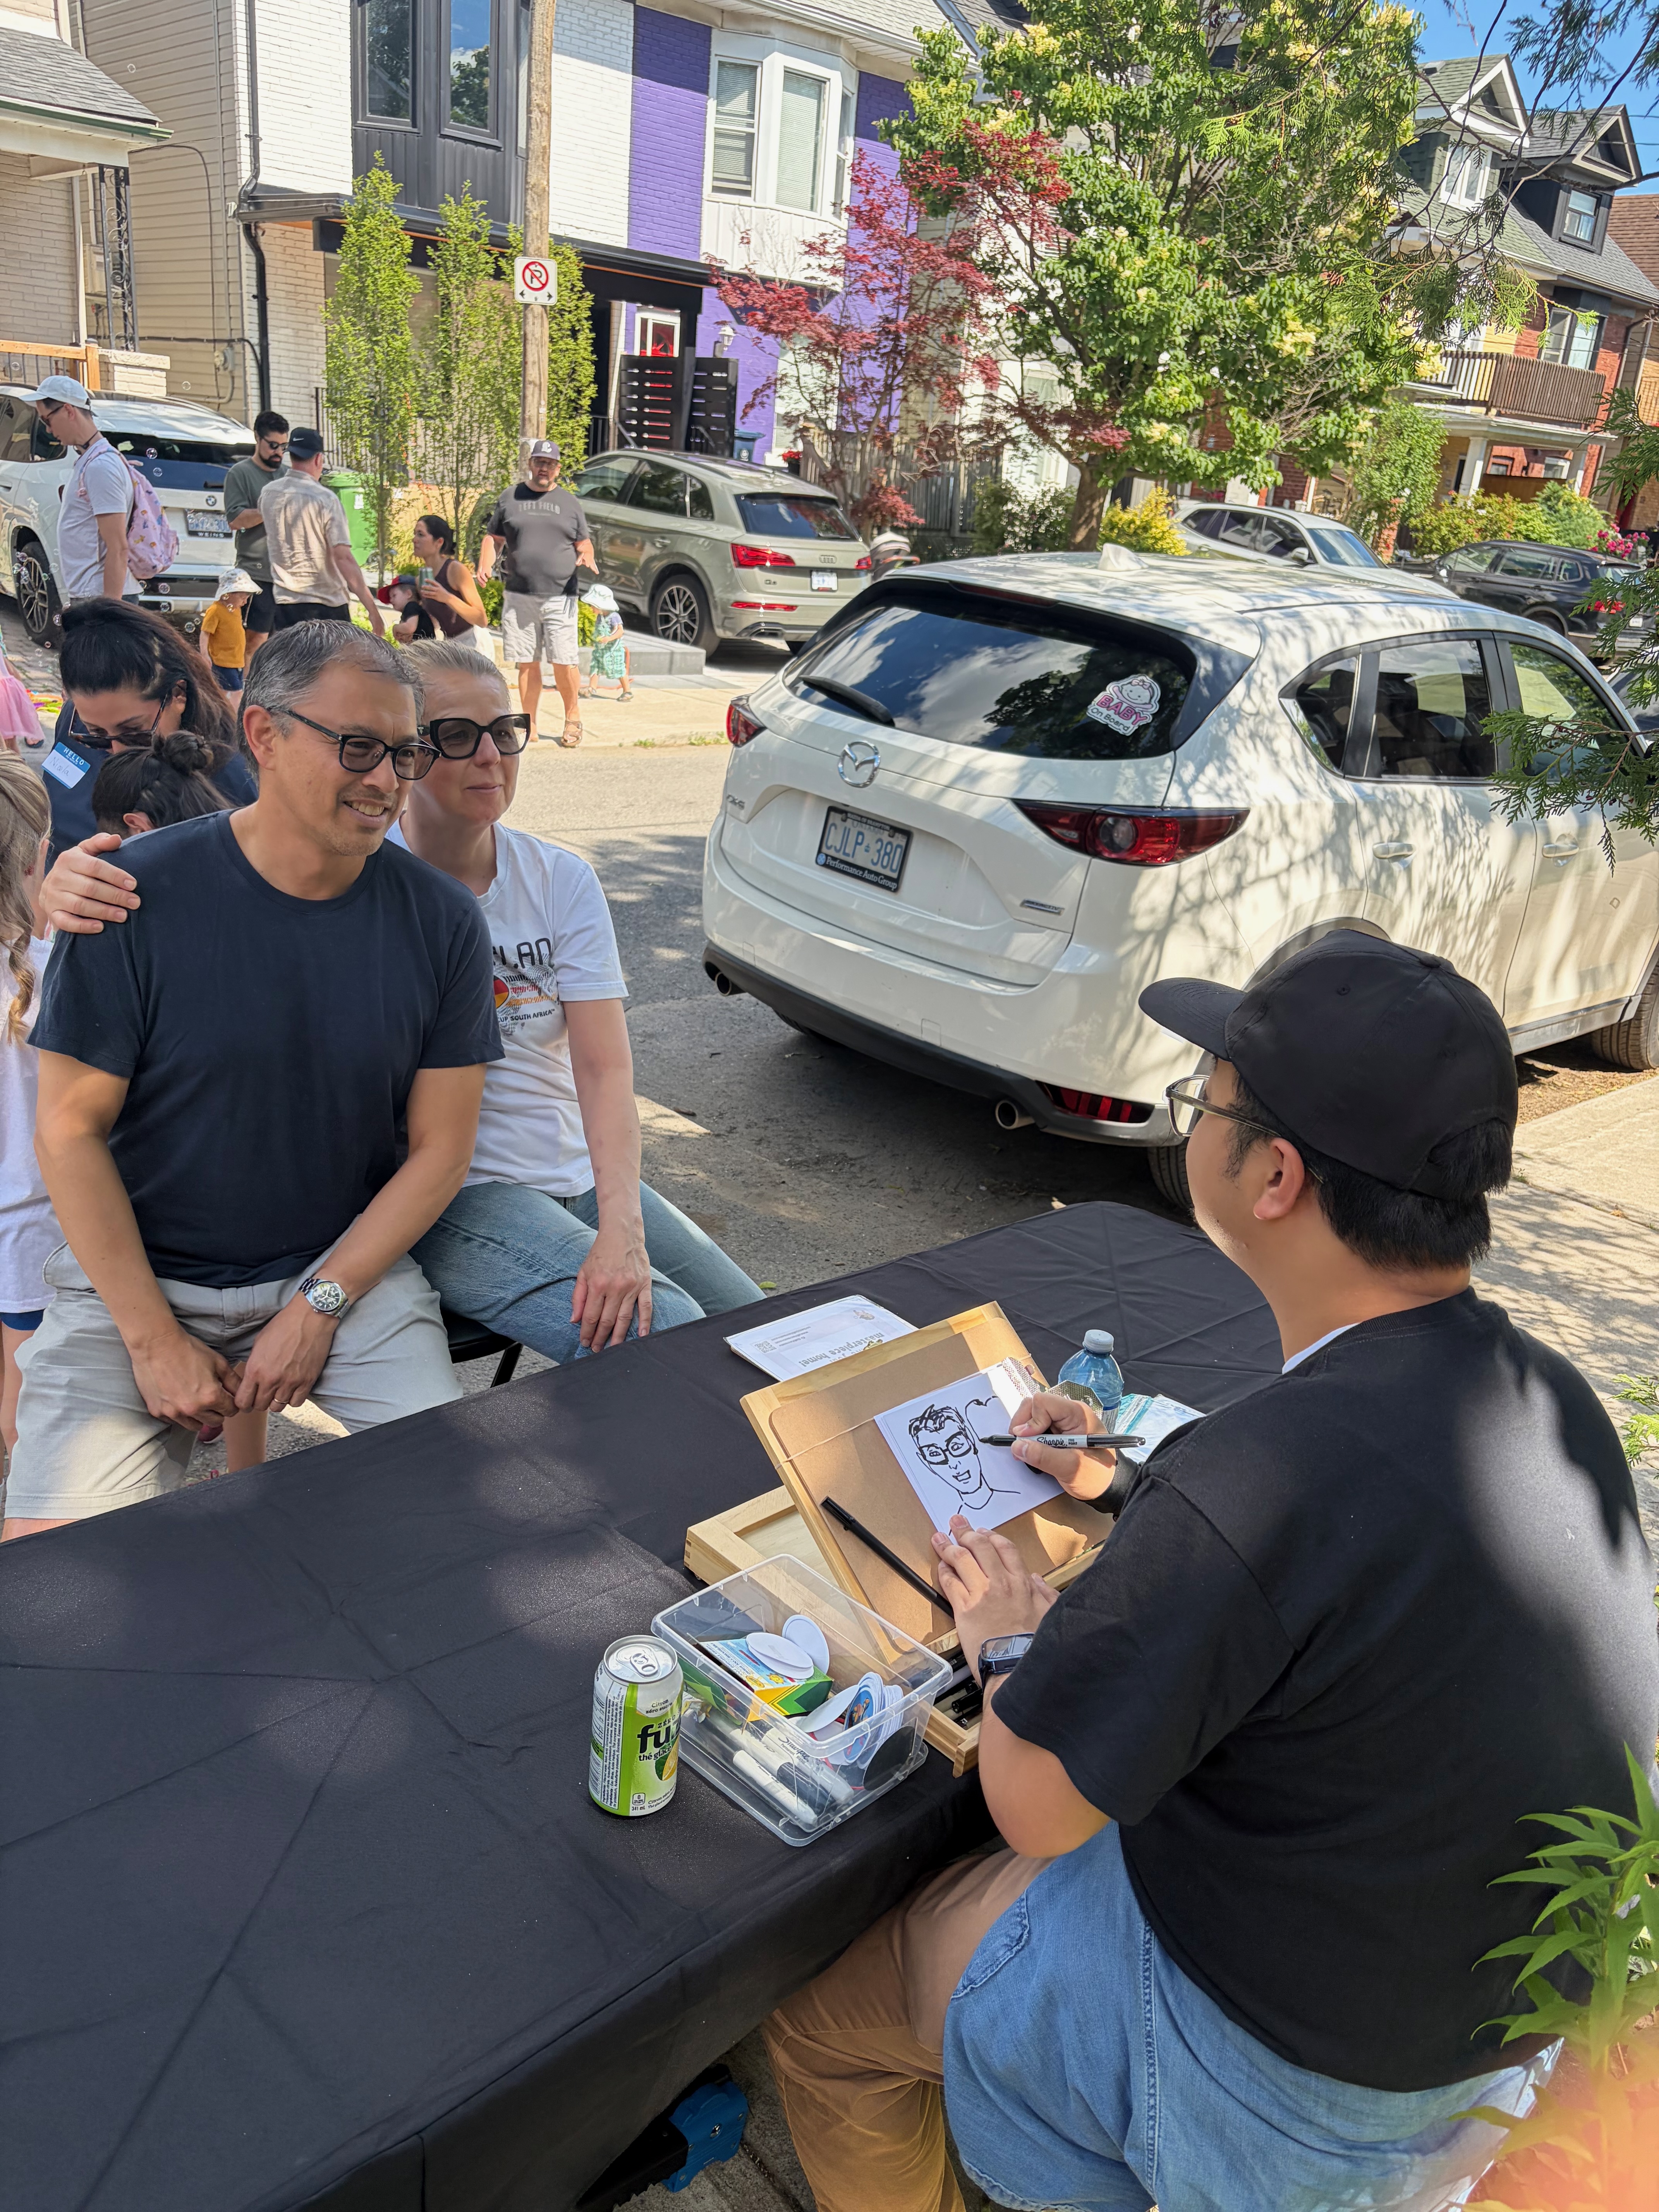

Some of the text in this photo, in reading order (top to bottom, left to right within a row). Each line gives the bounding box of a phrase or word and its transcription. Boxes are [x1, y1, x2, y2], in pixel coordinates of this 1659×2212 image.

[1091, 708, 1130, 731] On Board
[1096, 695, 1148, 725] BABY
[64, 747, 84, 765] HELLO
[825, 823, 903, 873] CJLP 380
[826, 857, 897, 891] Performance Auto Group
[829, 1333, 885, 1355] masterpiece
[799, 1353, 831, 1367] home!
[652, 1699, 668, 1708] Citron
[658, 1715, 676, 1729] ZÉRO
[639, 1752, 653, 1761] thé
